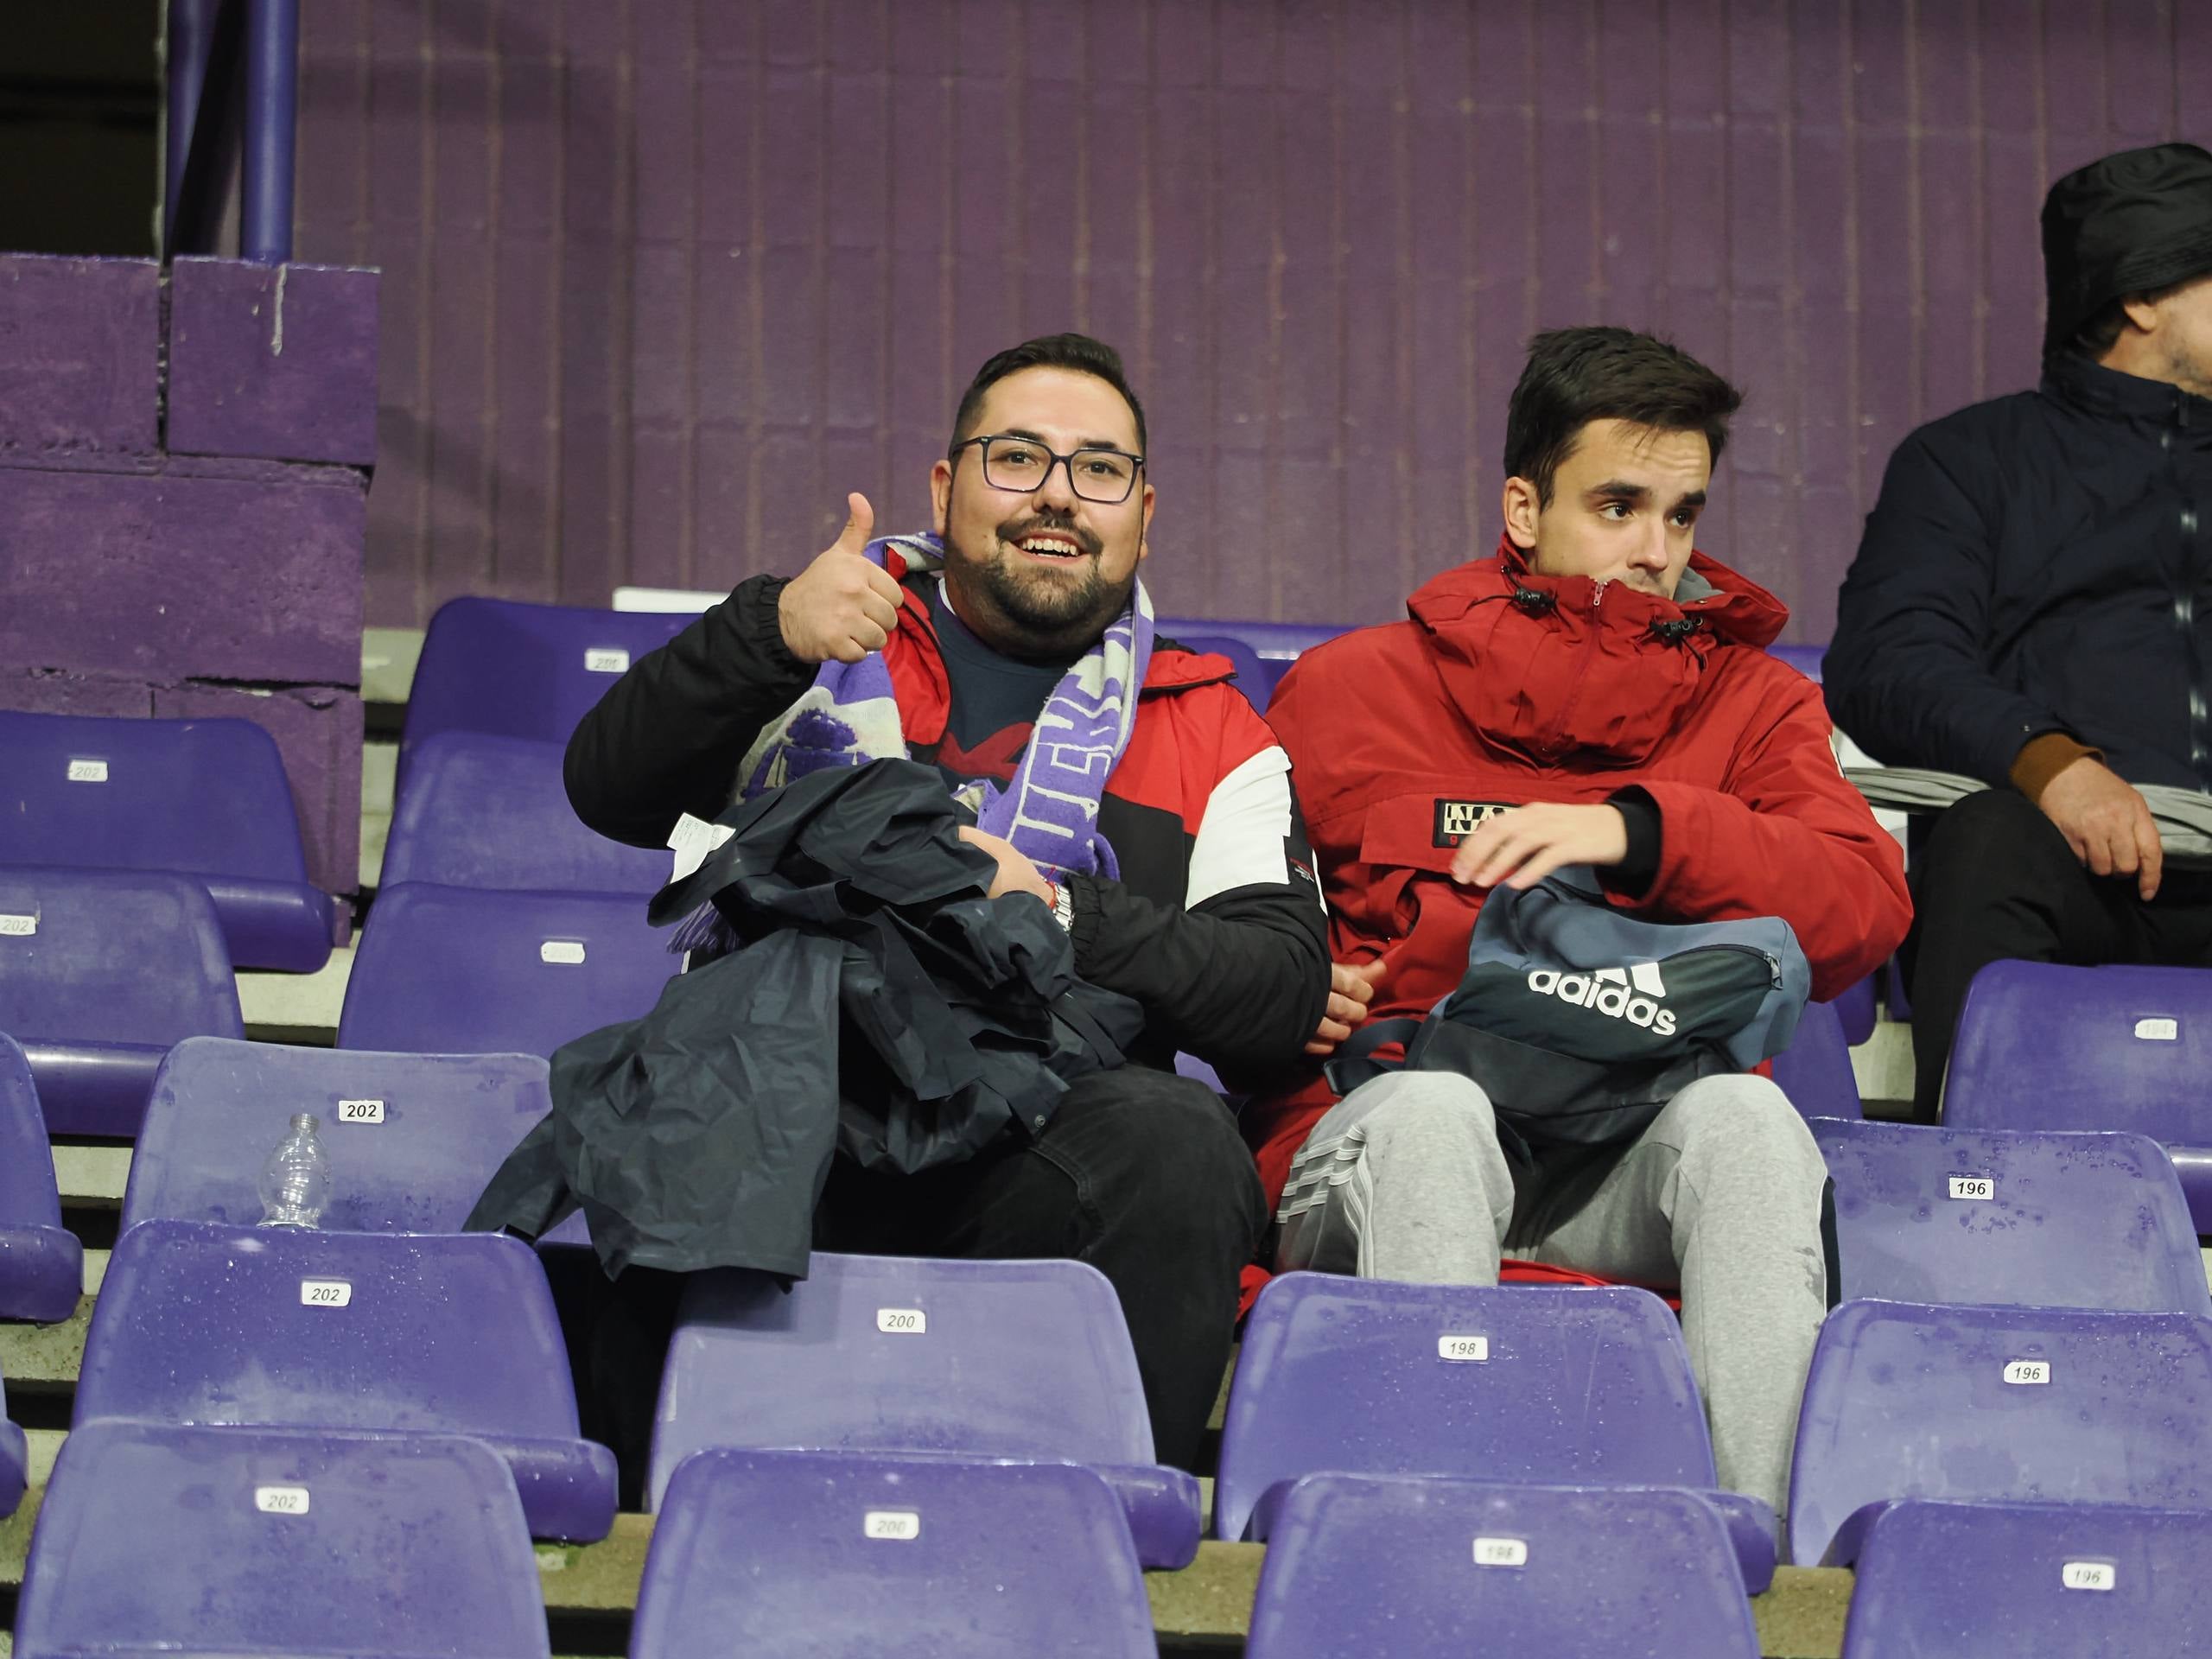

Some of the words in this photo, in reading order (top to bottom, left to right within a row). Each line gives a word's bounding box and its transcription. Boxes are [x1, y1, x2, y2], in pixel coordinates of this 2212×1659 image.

[74, 766, 100, 779] 202
[2, 919, 29, 932] 202
[1528, 970, 1676, 1036] adidas
[347, 1104, 377, 1118] 202
[1957, 1181, 1986, 1195] 196
[311, 1288, 340, 1302] 202
[887, 1314, 915, 1328] 200
[1450, 1343, 1476, 1356] 198
[2014, 1367, 2040, 1380] 196
[267, 1495, 297, 1509] 202
[878, 1521, 906, 1534] 200
[2075, 1569, 2101, 1583] 196
